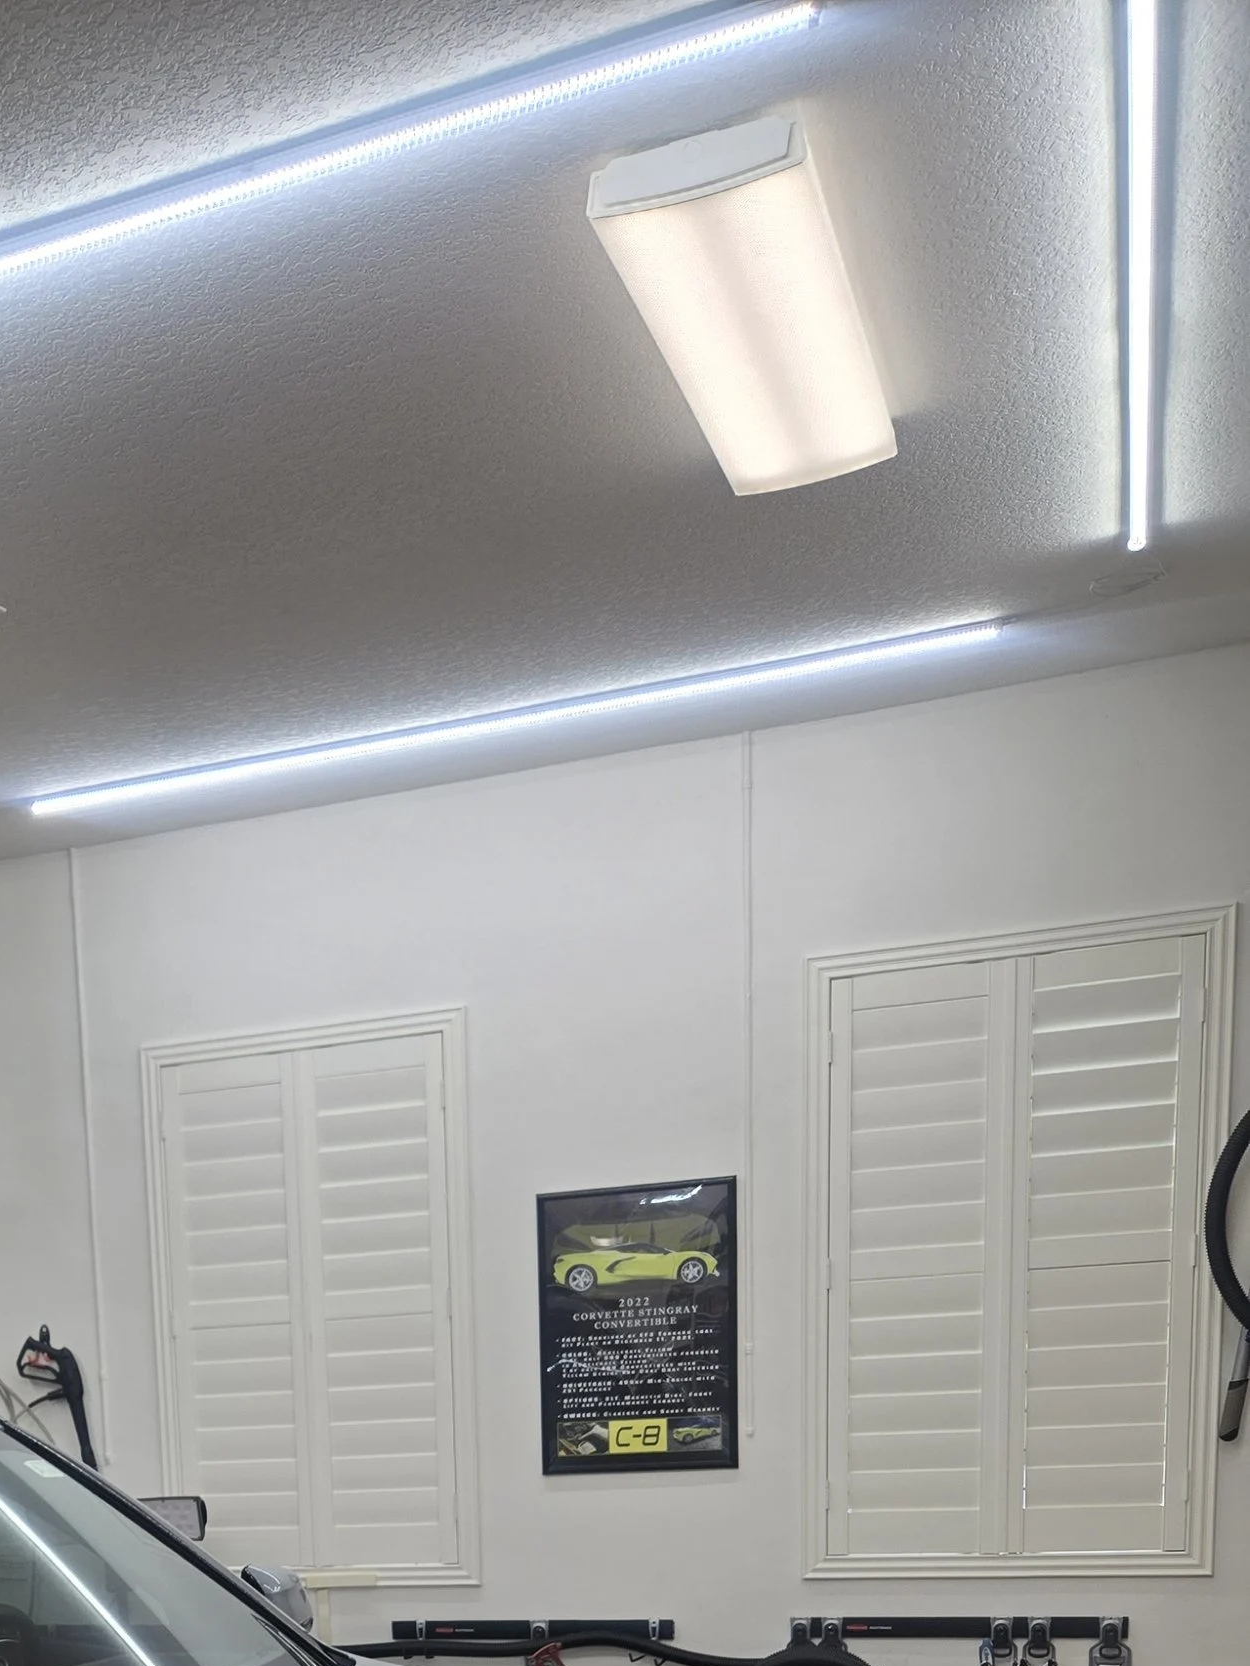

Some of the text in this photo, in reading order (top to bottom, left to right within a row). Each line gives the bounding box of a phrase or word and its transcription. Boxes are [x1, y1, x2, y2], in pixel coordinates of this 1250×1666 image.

[618, 1297, 650, 1308] 2022
[572, 1304, 699, 1322] CORVETTE STINGRAY
[594, 1316, 678, 1330] CONVERTIBLE
[616, 1425, 661, 1447] C-8
